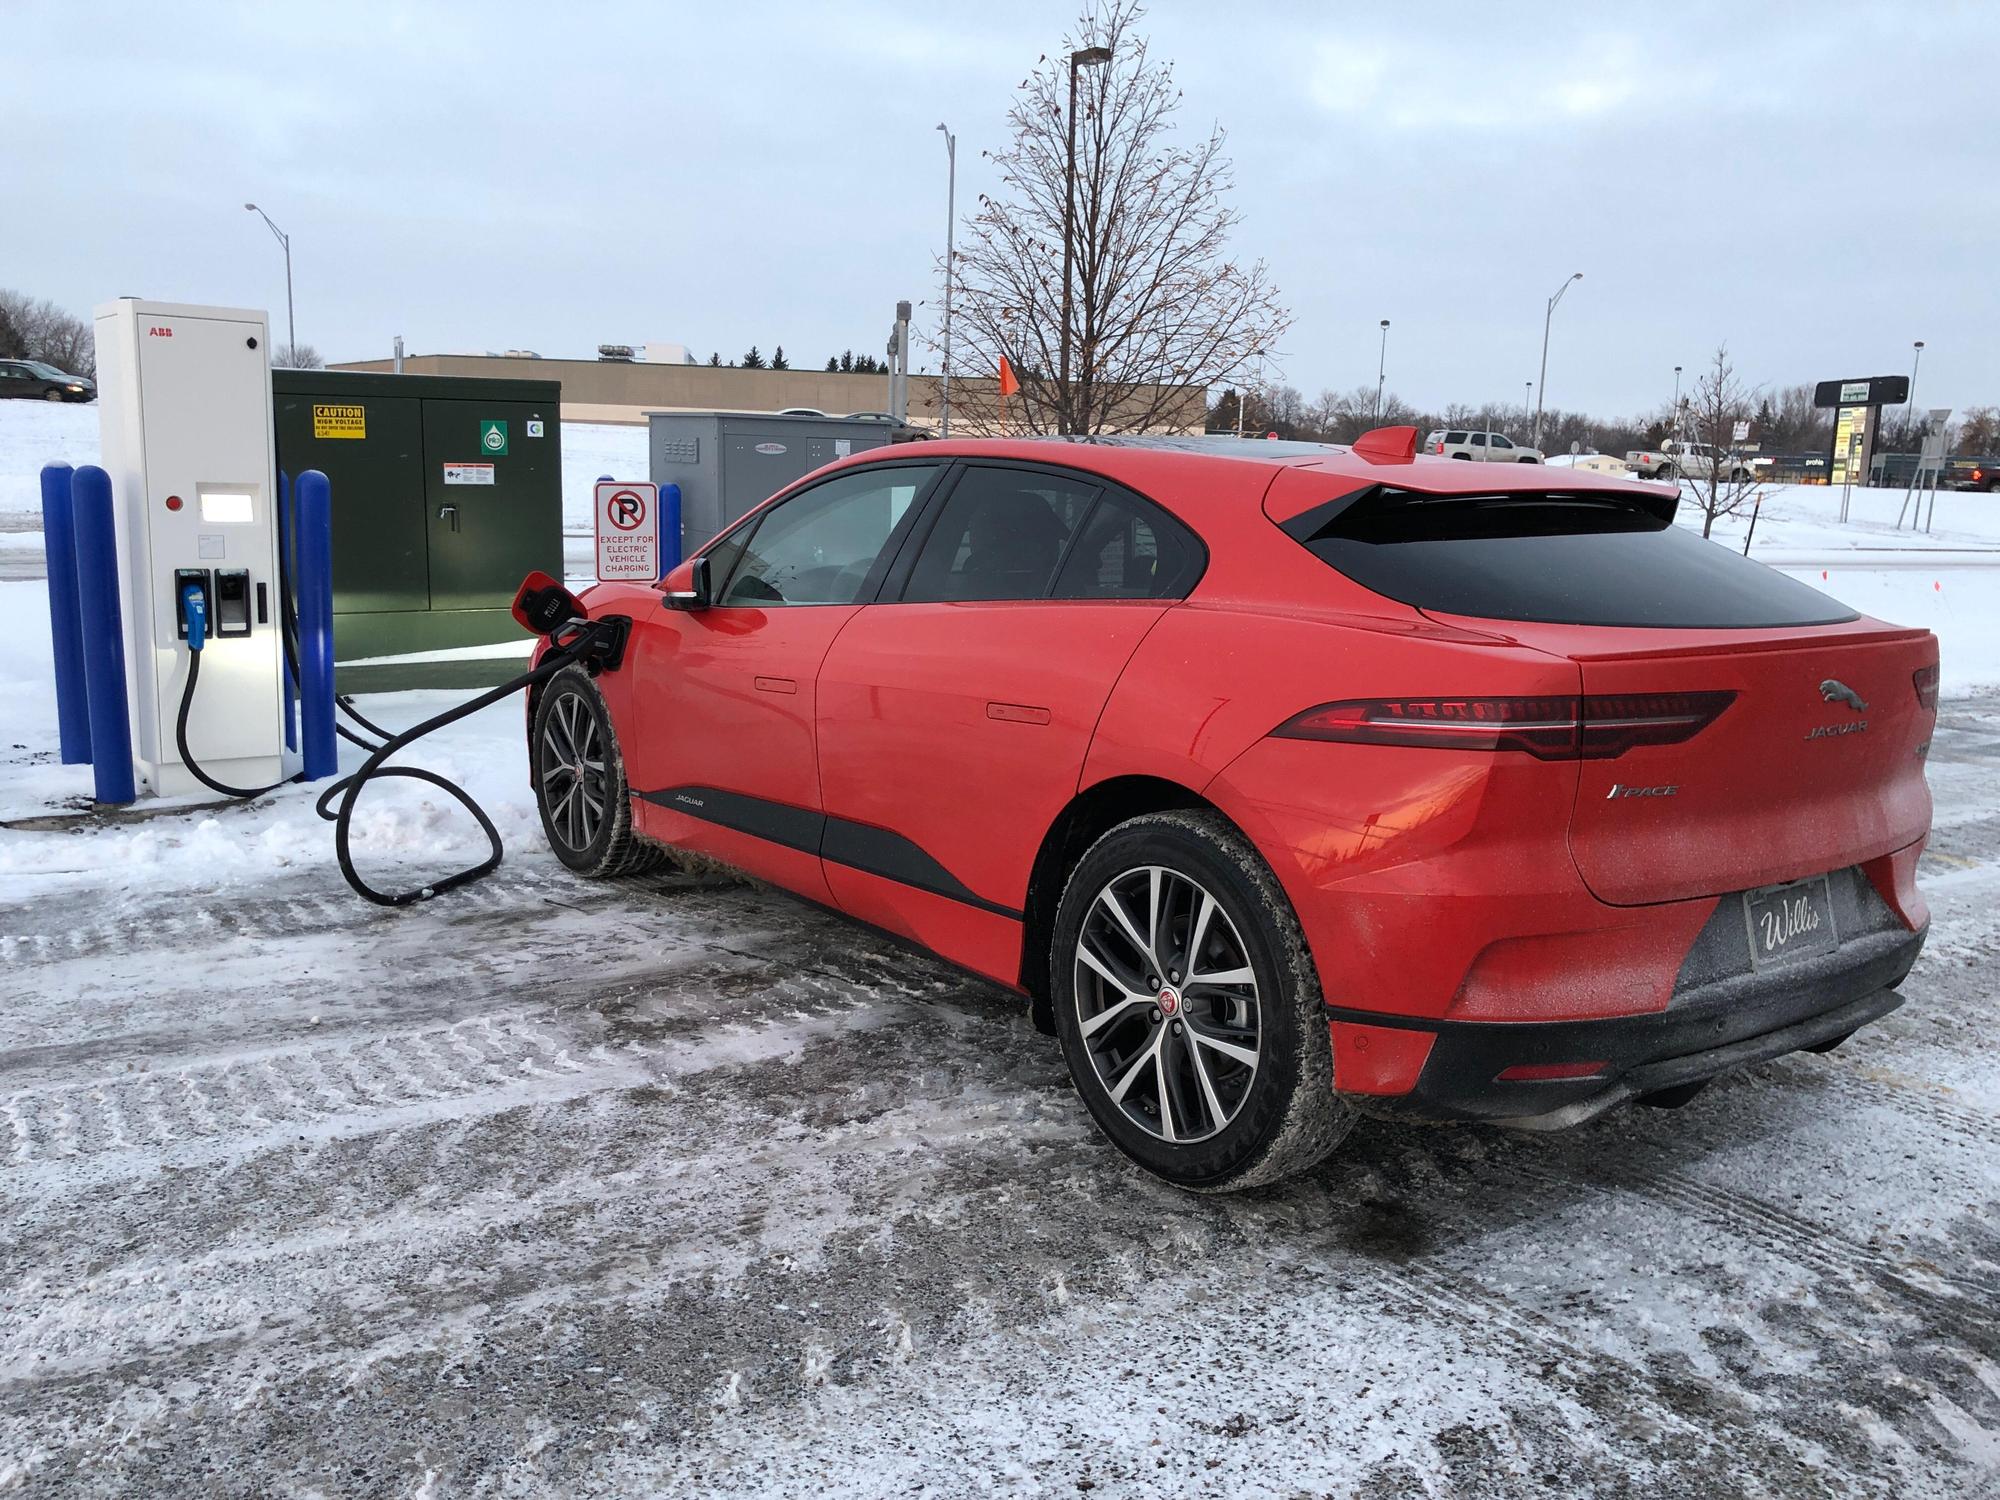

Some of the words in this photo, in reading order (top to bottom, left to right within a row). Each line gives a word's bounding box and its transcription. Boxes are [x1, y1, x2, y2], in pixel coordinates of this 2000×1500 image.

[150, 327, 173, 337] ABB
[316, 407, 362, 417] CAUTION
[600, 536, 634, 544] EXCEPT
[636, 536, 654, 544] FOR
[606, 545, 648, 553] ELECTRIC
[609, 555, 646, 563] VEHICLE
[605, 564, 650, 573] CHARGING
[1802, 720, 1868, 740] JAGUAR
[676, 794, 704, 808] JAGUAR
[1760, 896, 1821, 951] Willis
